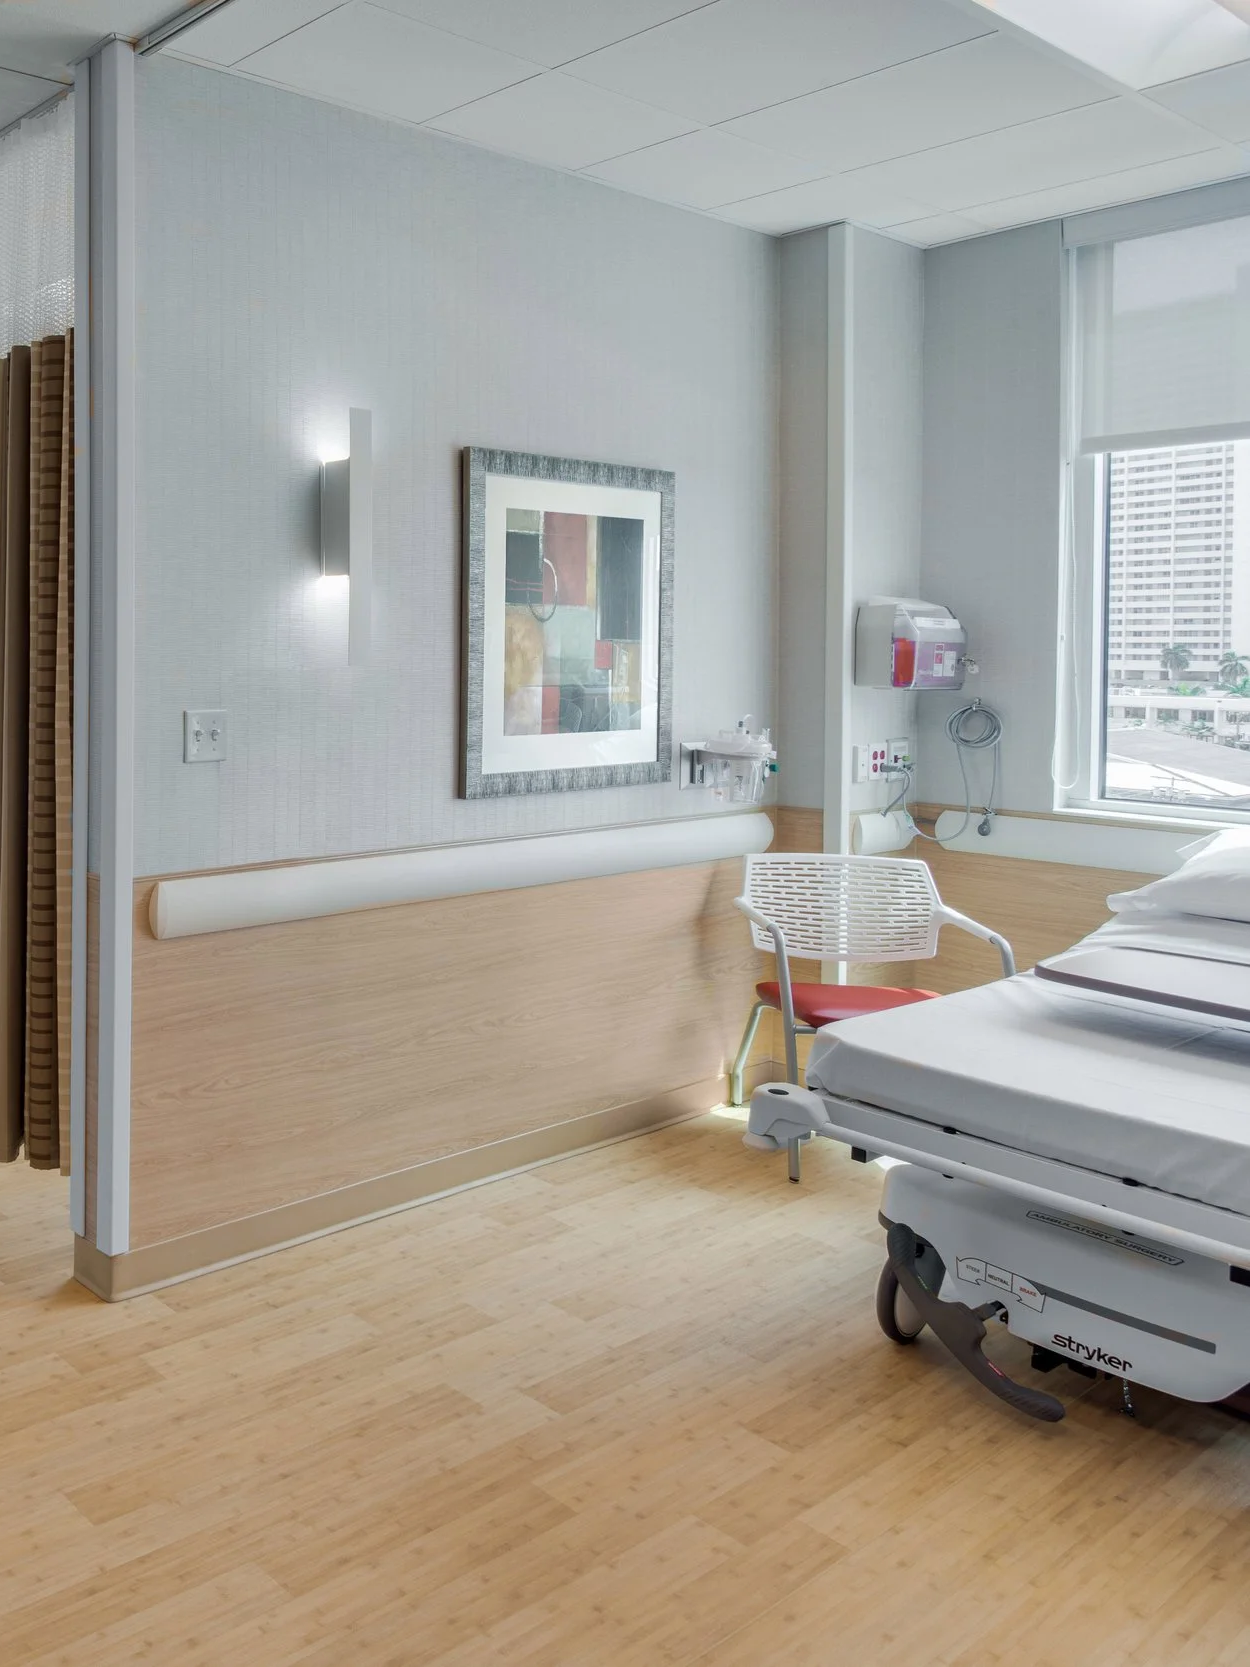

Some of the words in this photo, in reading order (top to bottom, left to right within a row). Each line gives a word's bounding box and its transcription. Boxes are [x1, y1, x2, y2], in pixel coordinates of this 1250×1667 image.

[1031, 1213, 1112, 1240] AMBULATORY
[1114, 1238, 1176, 1263] SURGERY
[987, 1273, 1010, 1286] NEUTRAL
[1019, 1286, 1037, 1297] BRAKE
[1051, 1333, 1133, 1372] stryker
